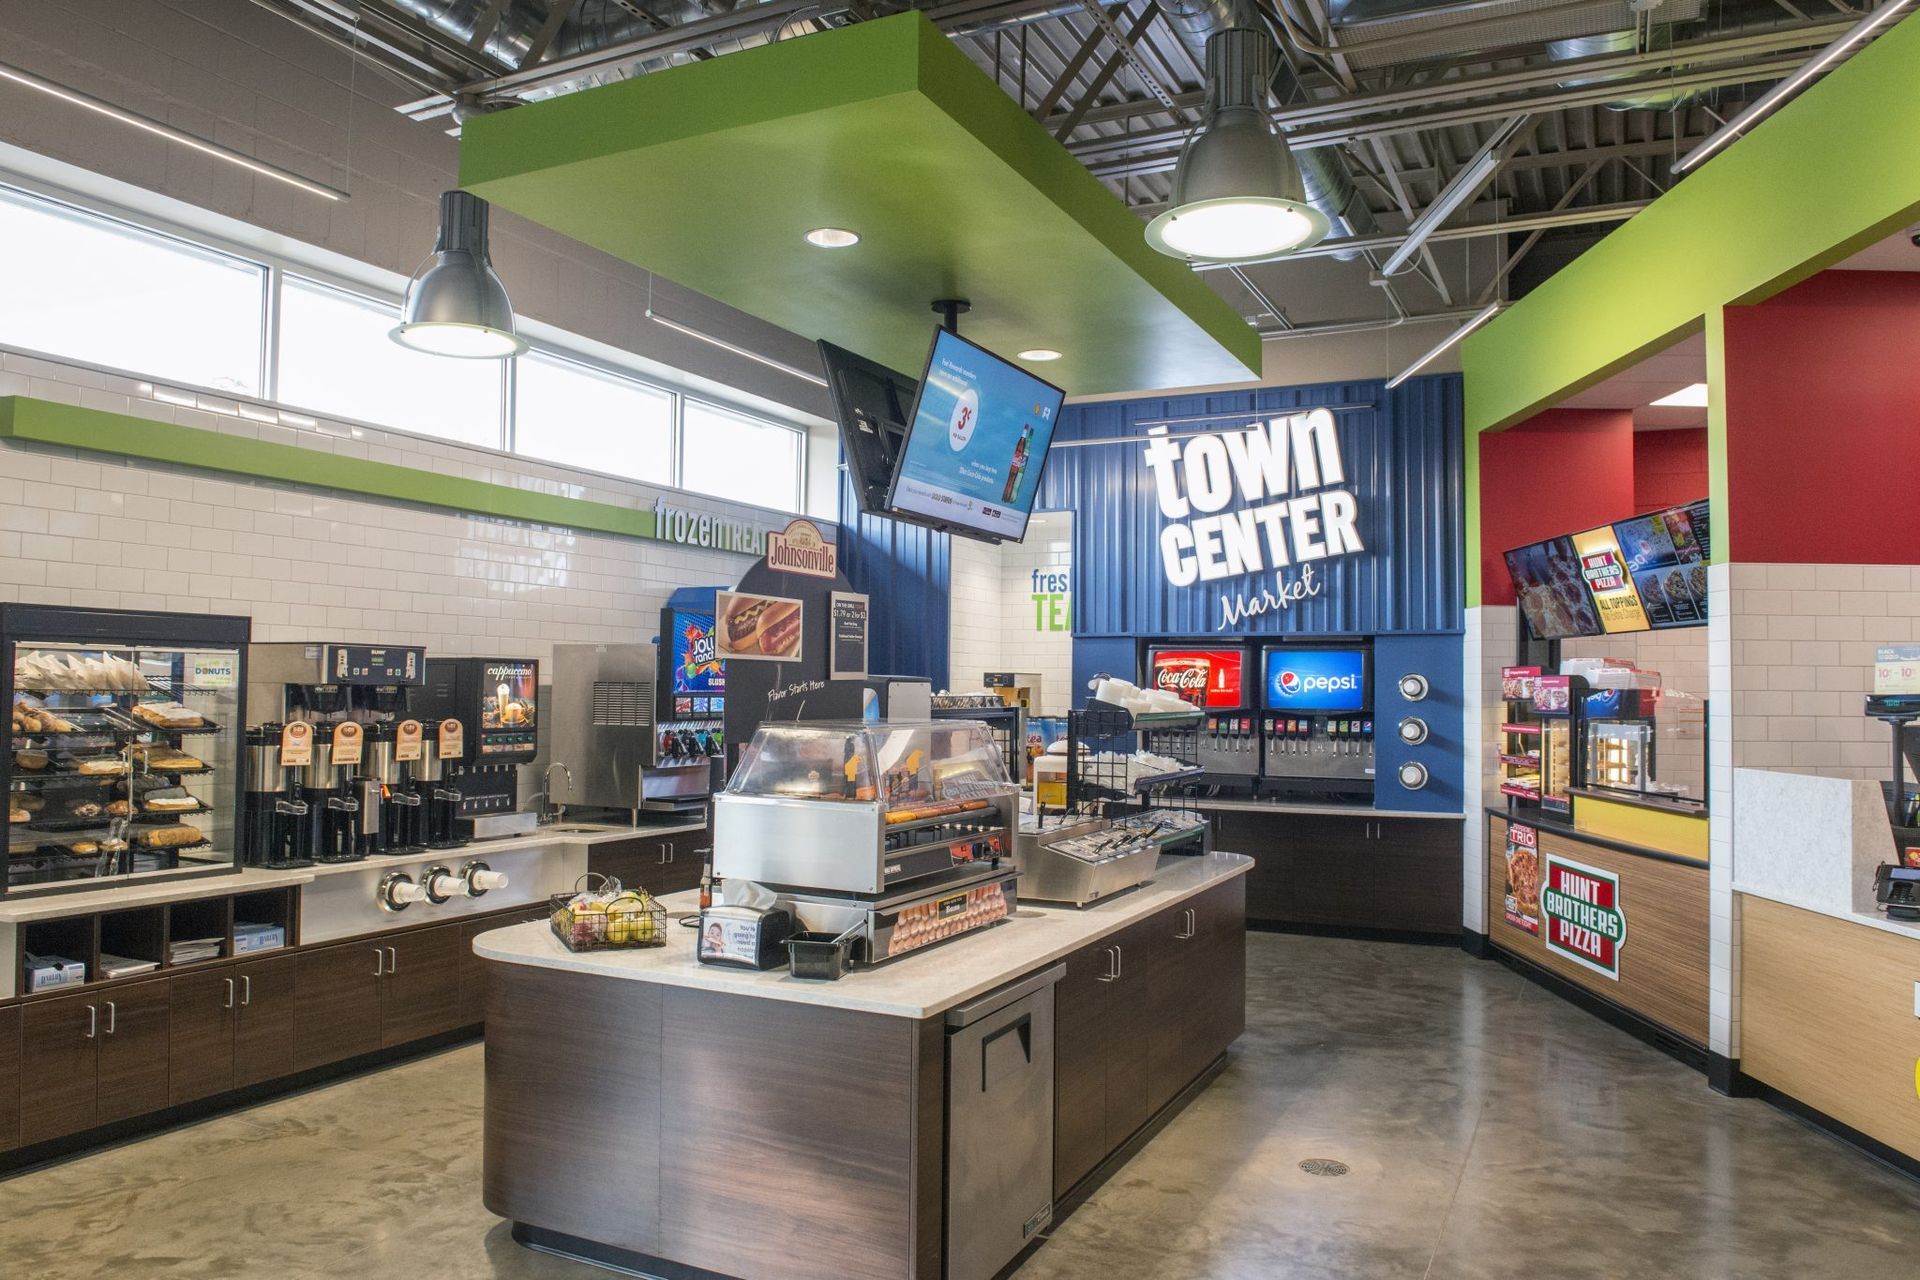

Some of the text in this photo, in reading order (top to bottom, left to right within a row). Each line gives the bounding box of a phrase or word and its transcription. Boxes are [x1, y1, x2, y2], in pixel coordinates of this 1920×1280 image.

[654, 495, 722, 549] frozen
[1160, 489, 1365, 587] CENTER
[771, 536, 834, 573] Johnsonville
[1217, 563, 1321, 631] Market
[195, 667, 231, 675] DONUTS
[487, 664, 532, 680] cappuccino
[1157, 668, 1208, 688] Coca-Cola
[1303, 674, 1355, 693] pepsi
[768, 680, 825, 702] Flavor Starts Here
[1027, 735, 1042, 744] tea
[1511, 829, 1535, 845] TRIO
[1560, 870, 1601, 906] HUNT
[1546, 890, 1618, 939] BROTHERS
[1560, 918, 1602, 958] PIZZA
